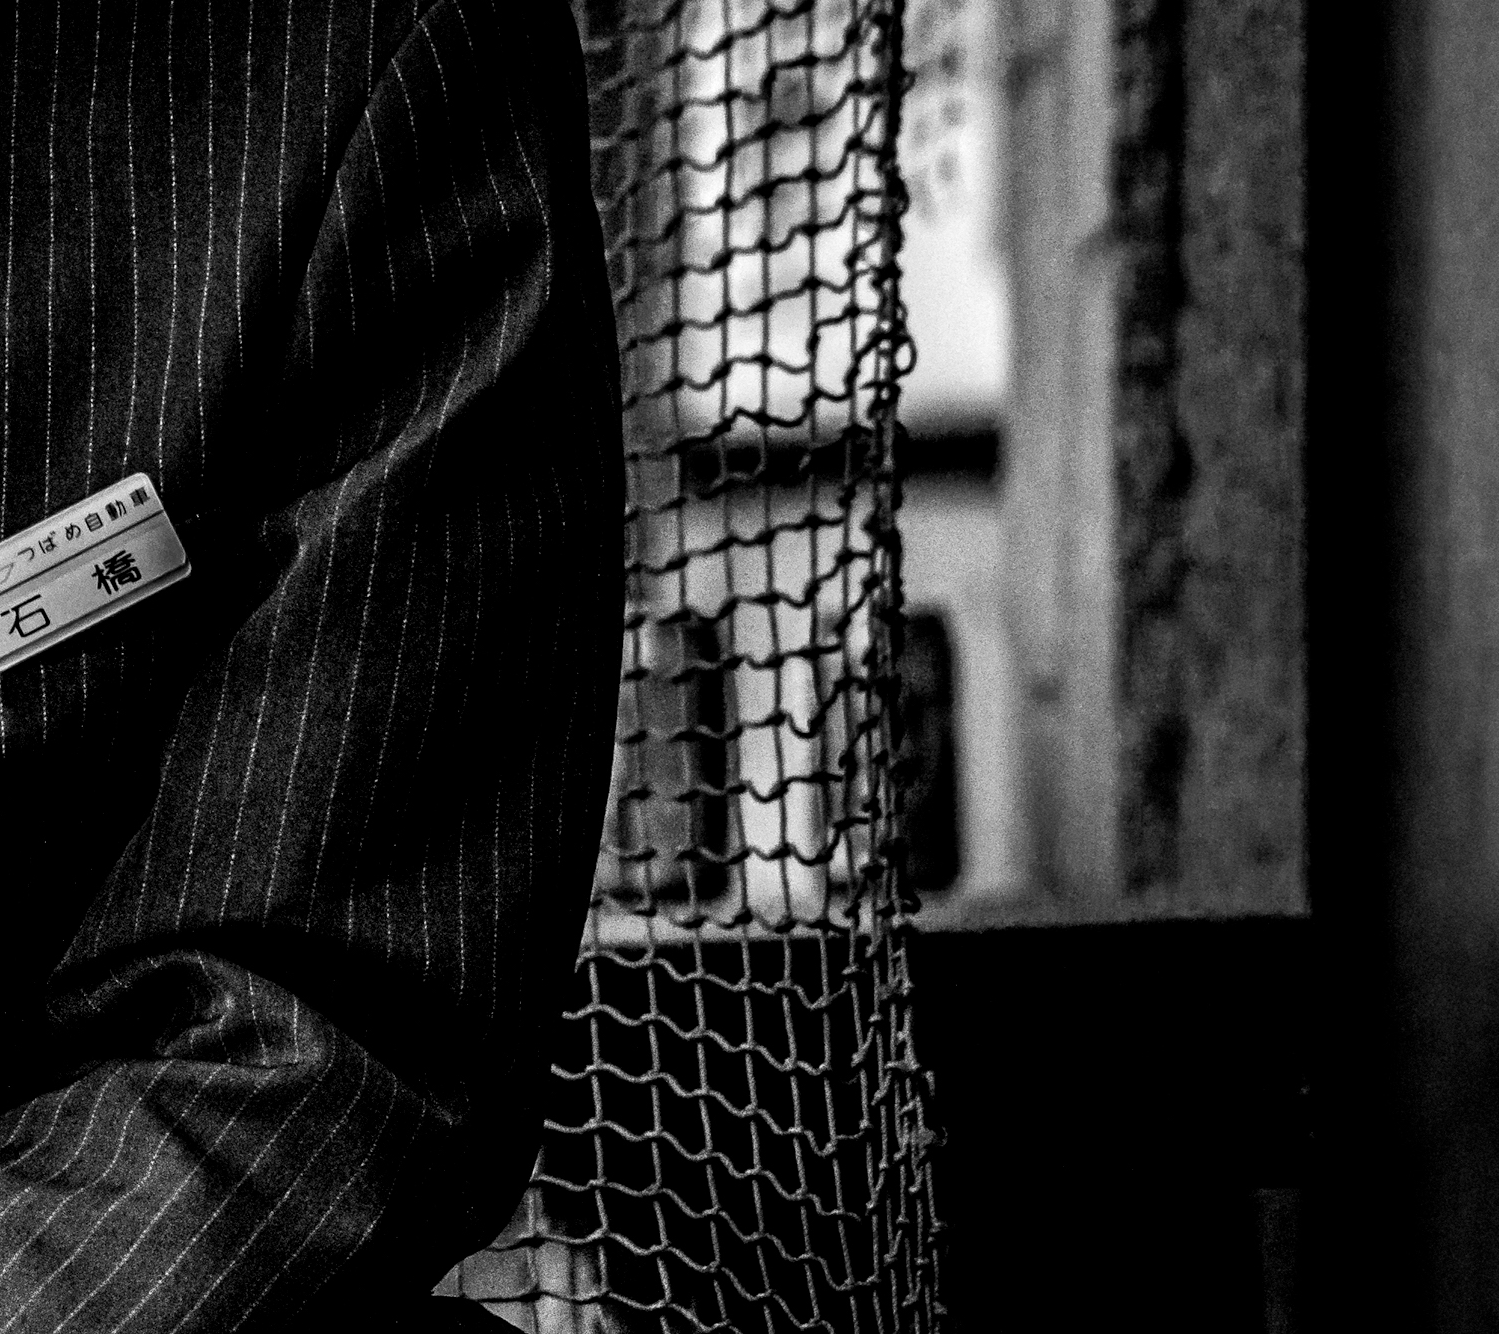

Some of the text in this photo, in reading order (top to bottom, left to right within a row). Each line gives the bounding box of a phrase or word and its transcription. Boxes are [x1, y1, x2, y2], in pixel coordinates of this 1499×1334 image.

[17, 487, 150, 561] つばめ自動車
